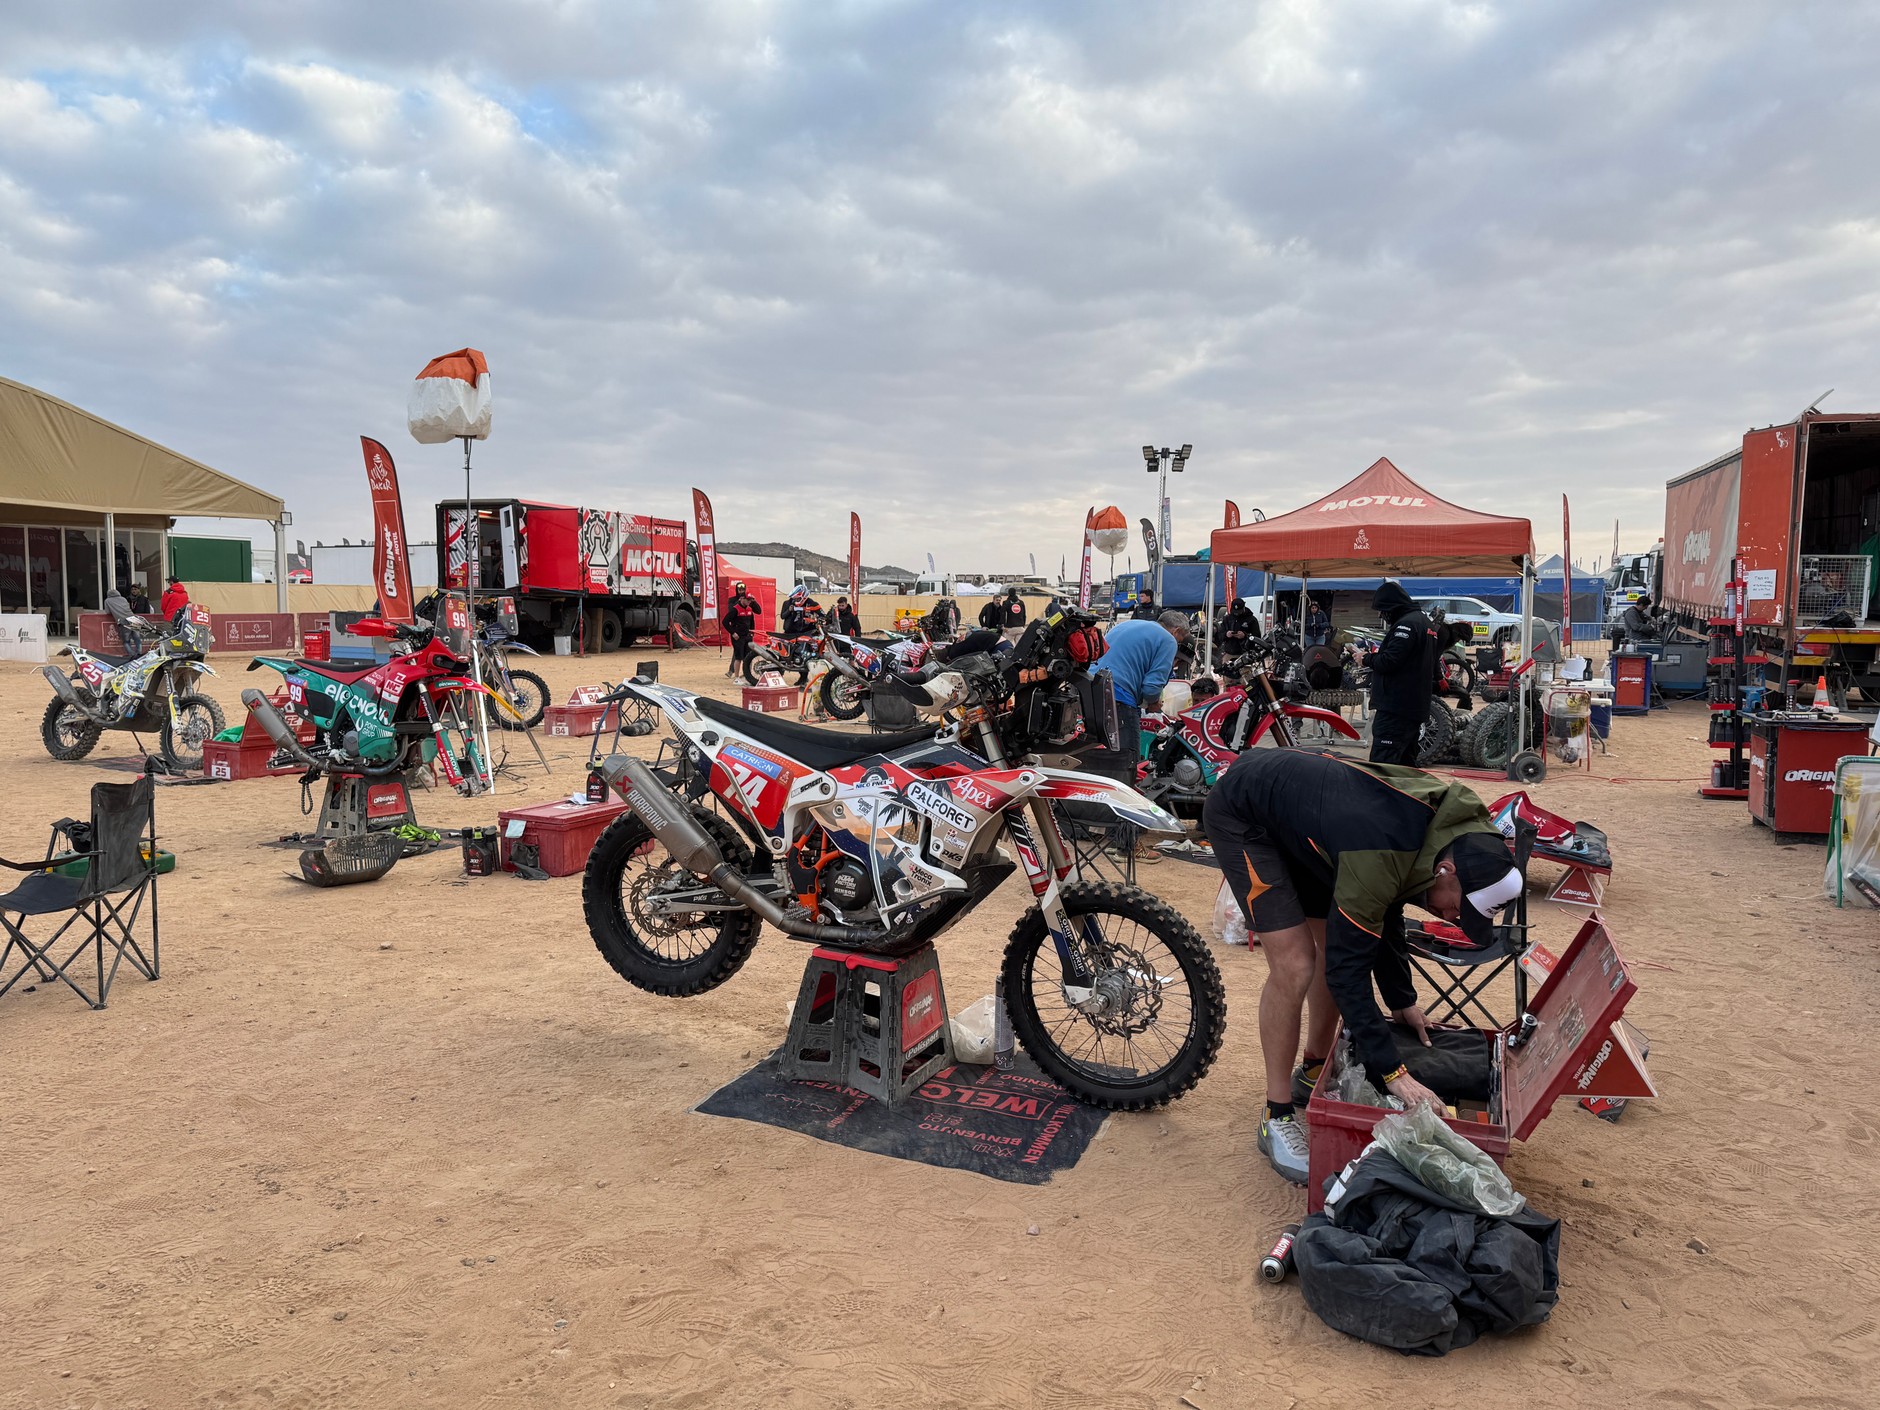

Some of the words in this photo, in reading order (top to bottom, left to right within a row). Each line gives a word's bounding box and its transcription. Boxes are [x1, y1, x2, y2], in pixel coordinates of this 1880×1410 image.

[371, 478, 393, 490] DAKAR
[1319, 495, 1428, 512] MOTUL
[620, 522, 646, 534] RACING
[384, 524, 399, 598] ORIGINAL
[625, 549, 683, 575] MOTUL
[704, 547, 715, 605] MOTUL
[197, 611, 209, 623] 25
[452, 612, 466, 628] 99
[855, 650, 866, 664] 63
[82, 665, 103, 683] 25
[290, 684, 302, 702] 99
[555, 727, 566, 736] 84
[1179, 725, 1218, 764] KOVE
[215, 768, 227, 777] 25
[1784, 769, 1836, 782] ORIGIN
[723, 763, 769, 817] 74
[800, 777, 823, 792] SCREEN
[953, 776, 996, 810] Apex
[626, 789, 669, 831] AKRAPOVIČ
[910, 785, 974, 829] PALFORET
[910, 871, 932, 887] Tronix
[914, 866, 933, 880] Meca
[1561, 888, 1591, 898] ORIGINAL
[909, 993, 933, 1018] ORIGINAL
[908, 1030, 939, 1058] Polisport
[1573, 1063, 1586, 1080] MOTUL
[1577, 1039, 1613, 1090] ORIGINAL
[1000, 1074, 1066, 1093] VENIDO
[918, 1083, 1039, 1115] WELC
[918, 1123, 1023, 1146] BENVENUTO
[1021, 1103, 1078, 1164] WILLKOMMEN
[1273, 1237, 1291, 1257] MOTUL
